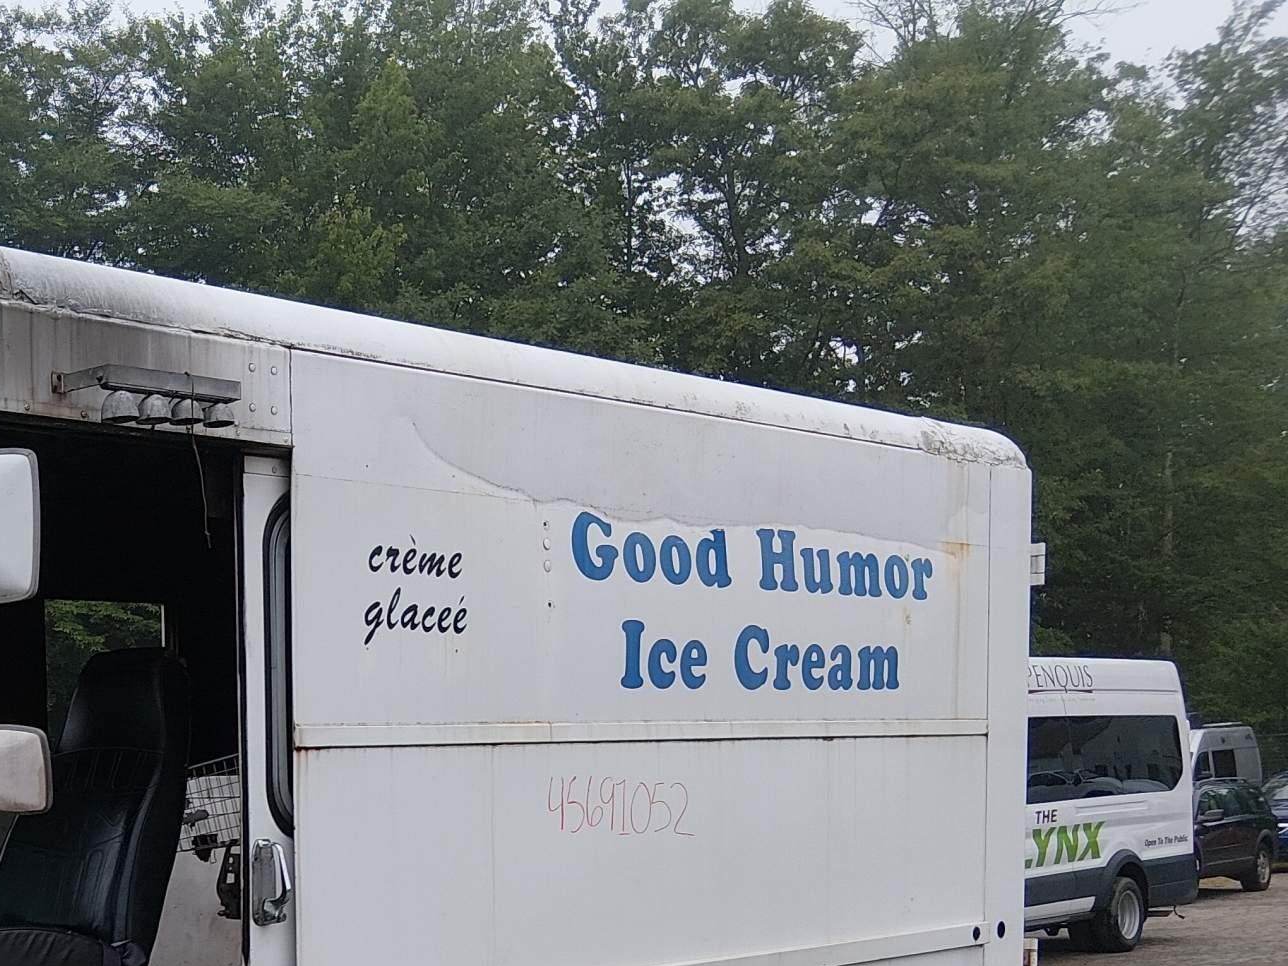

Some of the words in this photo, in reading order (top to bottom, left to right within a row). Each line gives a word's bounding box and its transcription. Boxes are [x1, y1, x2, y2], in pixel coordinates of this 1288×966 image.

[368, 534, 463, 579] crème
[570, 510, 733, 588] Good
[755, 527, 933, 601] Humor
[363, 588, 468, 646] glaceé
[620, 618, 708, 690] Ice
[733, 623, 900, 691] Cream
[547, 775, 696, 837] 45691052
[1035, 808, 1058, 824] THE
[1024, 820, 1106, 869] YNX
